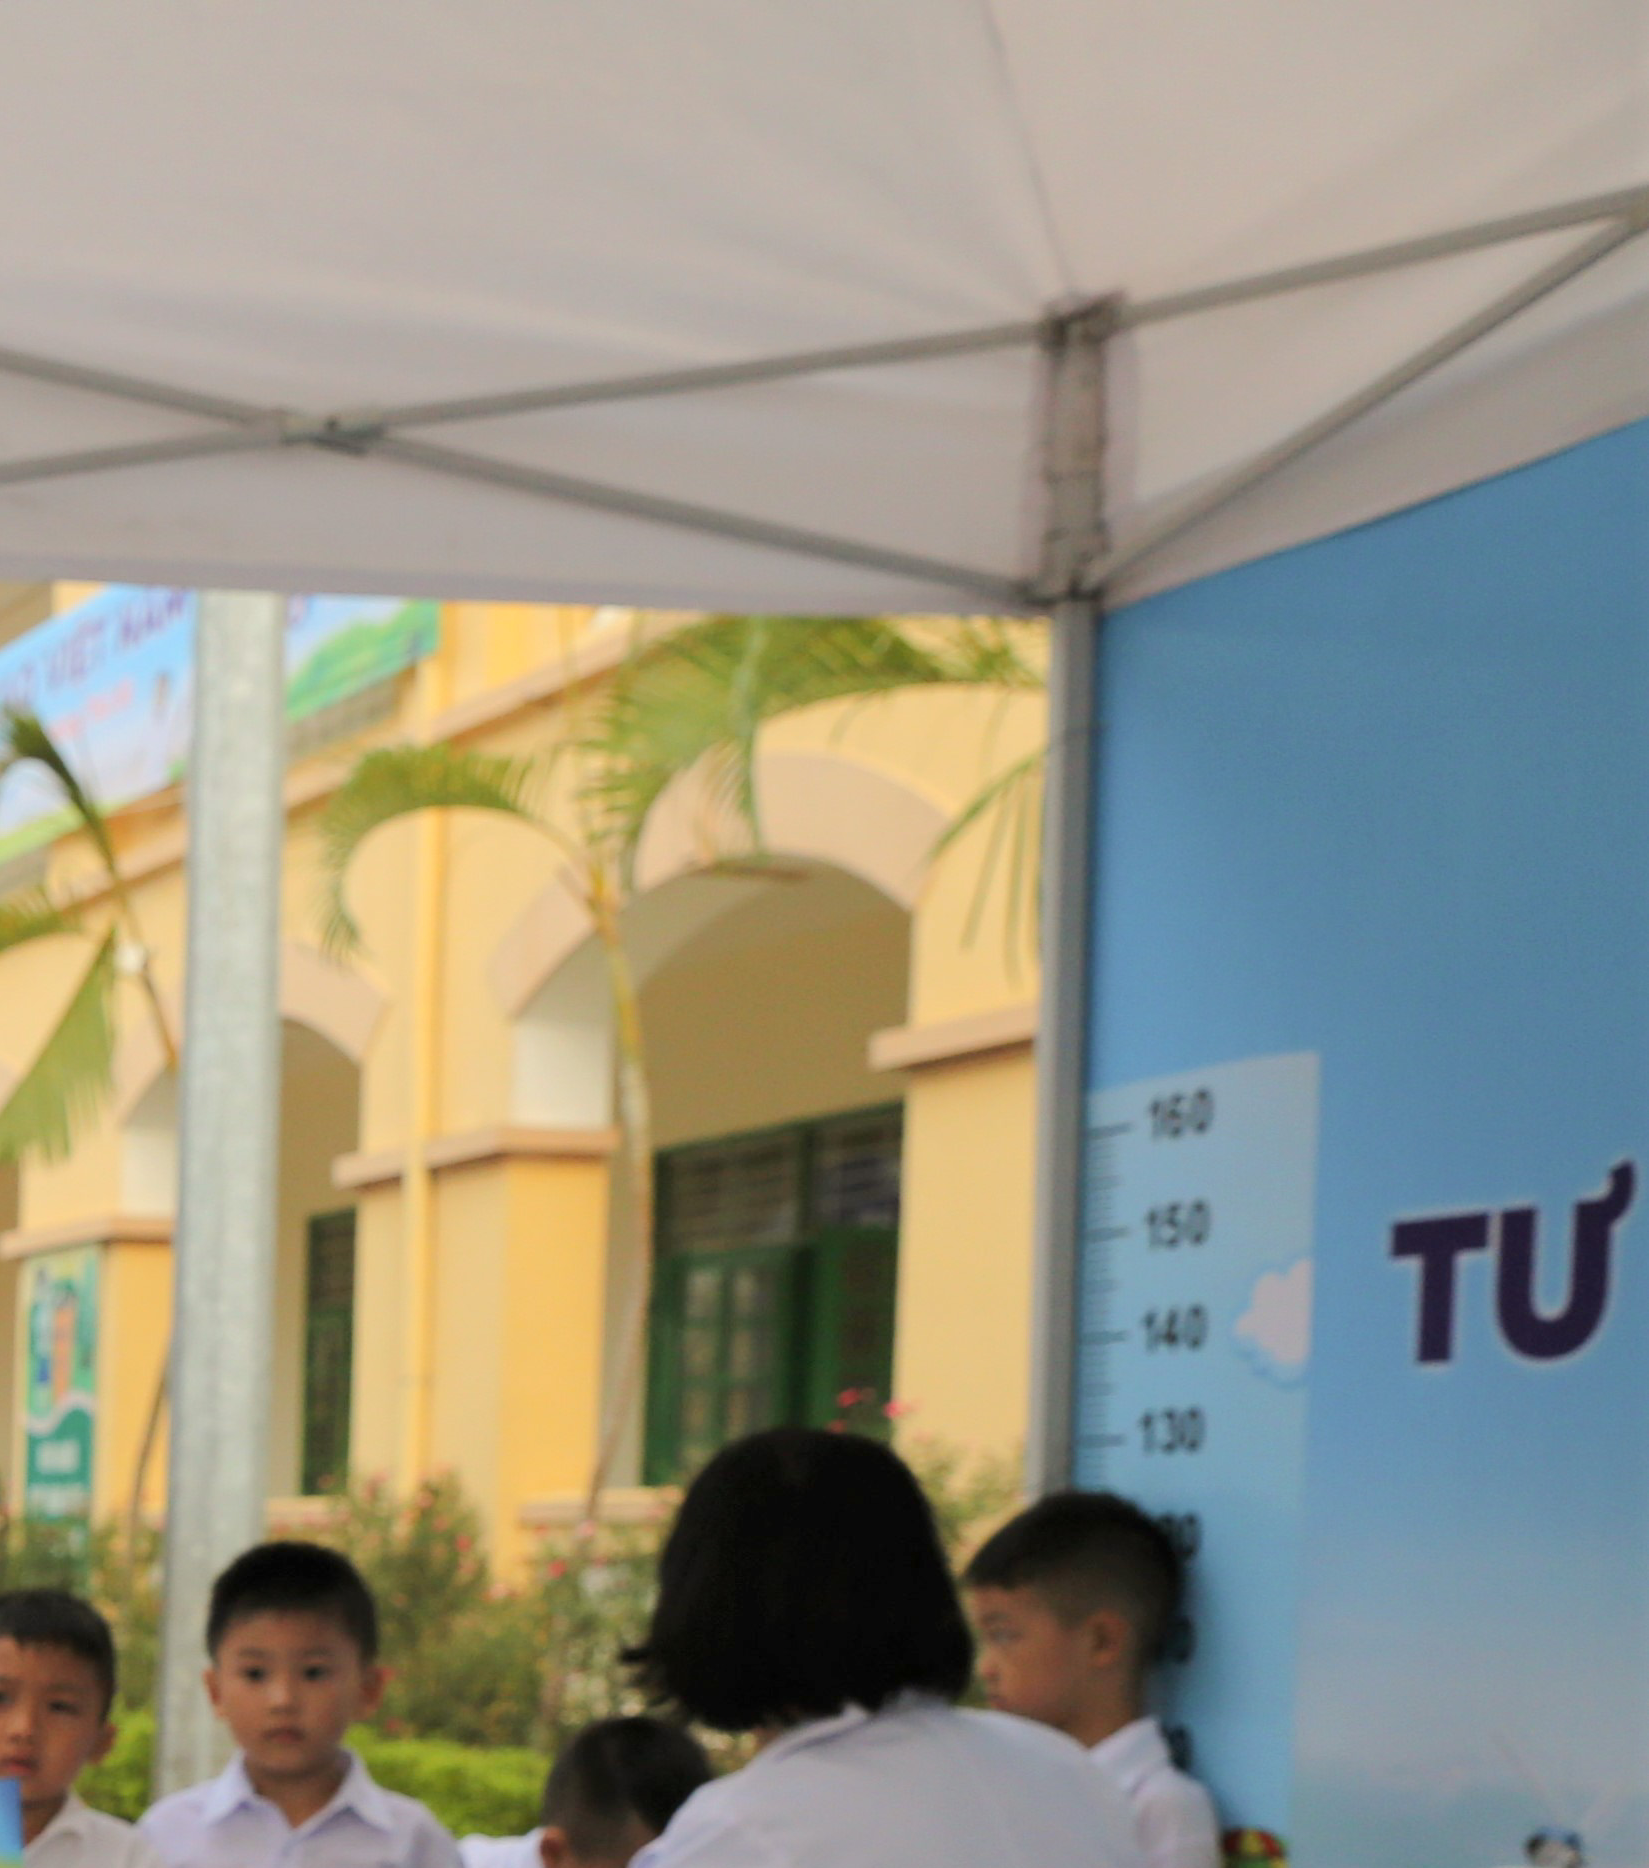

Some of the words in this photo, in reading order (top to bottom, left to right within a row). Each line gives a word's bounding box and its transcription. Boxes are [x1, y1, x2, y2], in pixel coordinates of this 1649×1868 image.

[1147, 1087, 1215, 1140] 160
[1144, 1202, 1211, 1249] 150
[1389, 1158, 1636, 1364] TƯ
[1140, 1306, 1208, 1353] 140
[1138, 1408, 1204, 1455] 130
